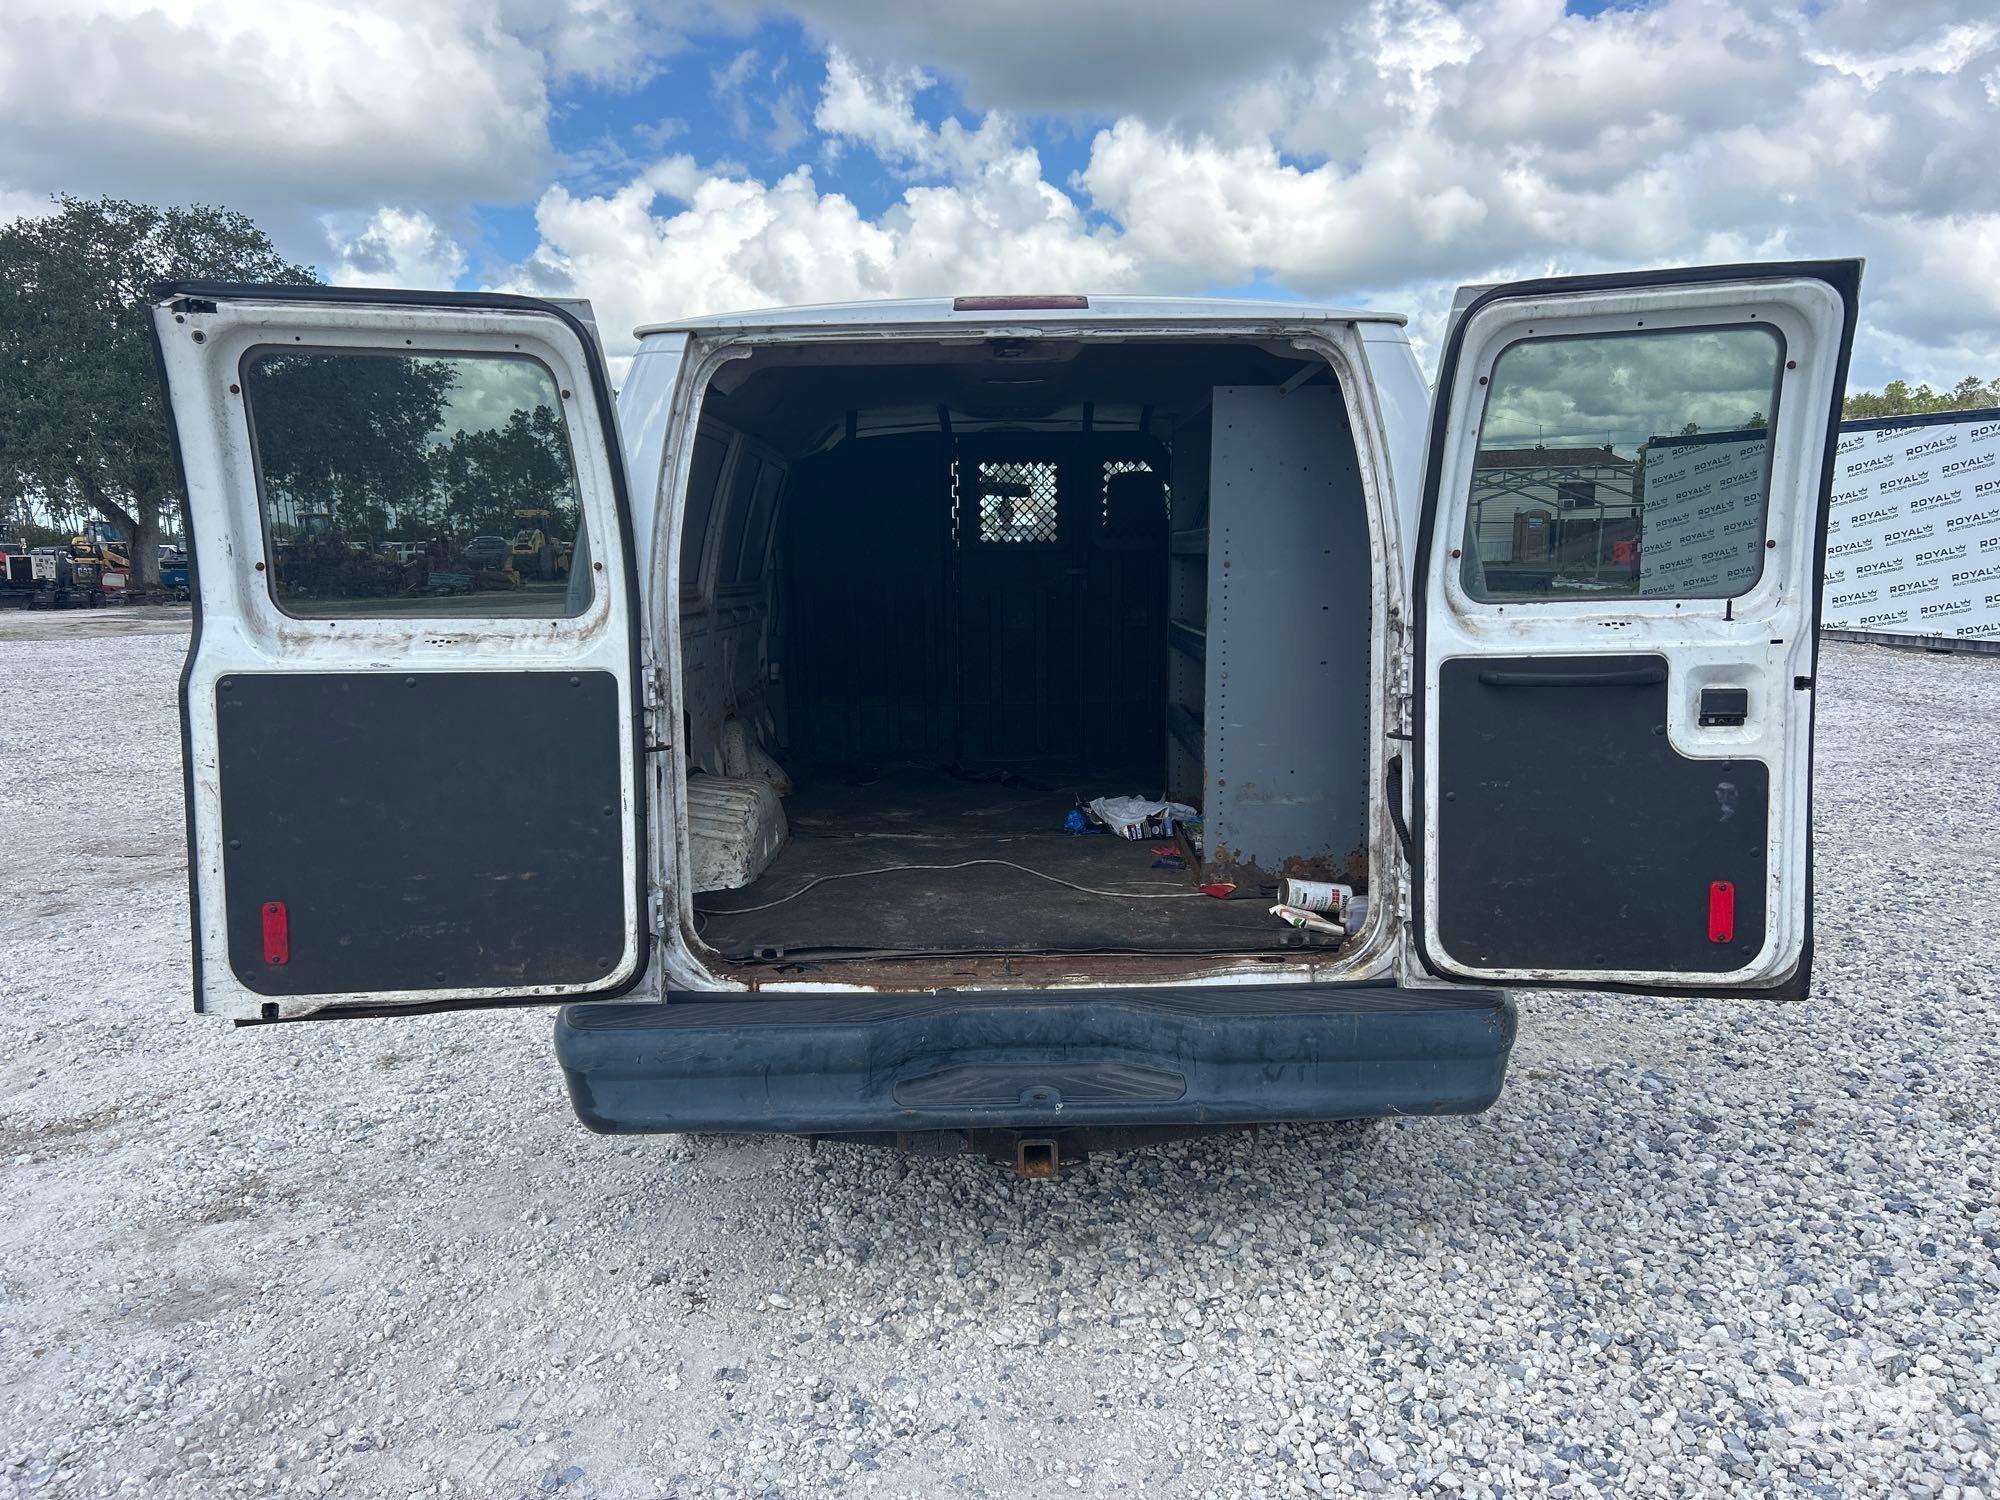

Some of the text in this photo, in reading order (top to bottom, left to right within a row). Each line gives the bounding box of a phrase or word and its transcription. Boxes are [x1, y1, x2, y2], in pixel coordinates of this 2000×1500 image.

[1971, 424, 2000, 437] ROY
[1878, 433, 1903, 443] AUCTION
[1906, 440, 1946, 456] ROYAL
[1908, 450, 1934, 460] AUCTION
[1694, 458, 1723, 471] ROYAL
[1847, 458, 1883, 473] ROYAL
[1942, 457, 1983, 473] ROYAL
[1652, 472, 1678, 485] ROYAL
[1848, 468, 1873, 478] AUCTION
[1943, 468, 1971, 478] AUCTION
[1720, 473, 1749, 486] ROYAL
[1880, 475, 1918, 490] ROYAL
[1881, 485, 1907, 495] AUCTION
[1975, 480, 2000, 492] ROY
[1676, 487, 1703, 500] ROYAL
[1830, 491, 1858, 503] OYAL
[1911, 494, 1950, 508] ROYAL
[1698, 503, 1726, 515] ROYAL
[1912, 504, 1939, 514] AUCTION
[1656, 515, 1682, 528] ROYAL
[1852, 509, 1888, 523] ROYAL
[1947, 513, 1988, 527] ROYAL
[1724, 520, 1753, 531] ROYAL
[1852, 518, 1877, 528] AUCTION
[1948, 523, 1976, 532] AUCTION
[1680, 532, 1707, 543] ROYAL
[1885, 528, 1923, 541] ROYAL
[1828, 541, 1863, 554] ROYAL
[1886, 538, 1911, 546] AUCTION
[1702, 549, 1730, 560] ROYAL
[1829, 551, 1853, 559] AUCTION
[1916, 548, 1955, 561] ROYAL
[1660, 560, 1686, 570] ROYAL
[1917, 556, 1944, 566] AUCTION
[1856, 561, 1893, 574] ROYAL
[1858, 570, 1882, 578] AUCTION
[1952, 568, 1993, 581] ROYAL
[1683, 576, 1710, 587] ROYAL
[1890, 581, 1928, 593] ROYAL
[1953, 578, 1981, 586] AUCTION
[1832, 592, 1867, 604] ROYAL
[1921, 602, 1960, 614] ROYAL
[1860, 613, 1898, 624] ROYAL
[1922, 611, 1949, 619] AUCTION
[1957, 623, 1998, 635] ROYAL
